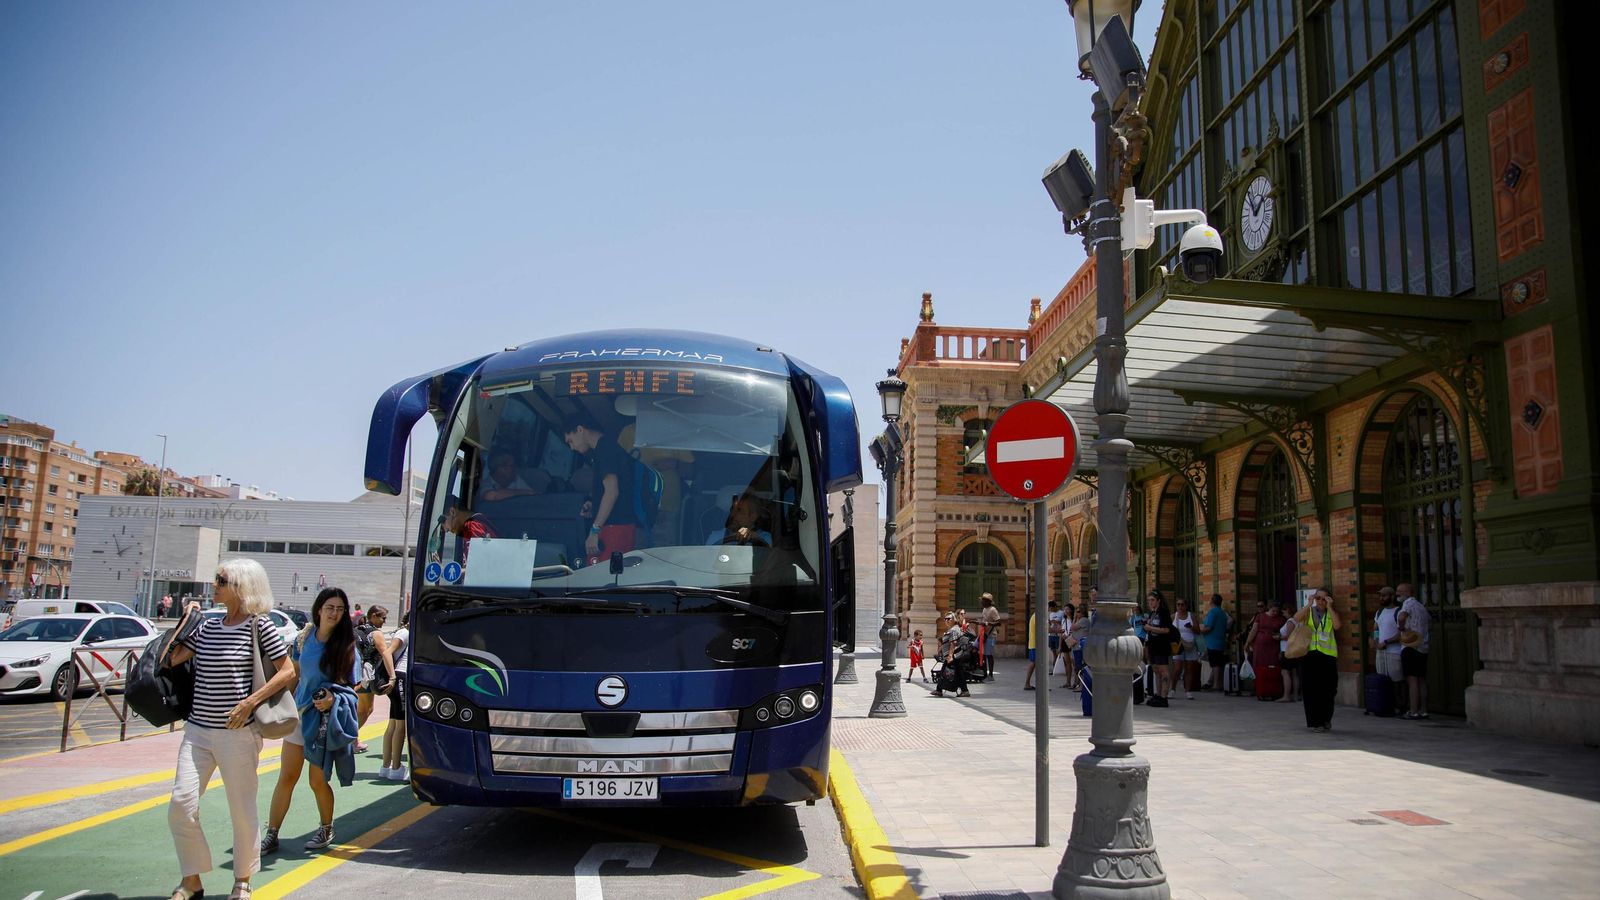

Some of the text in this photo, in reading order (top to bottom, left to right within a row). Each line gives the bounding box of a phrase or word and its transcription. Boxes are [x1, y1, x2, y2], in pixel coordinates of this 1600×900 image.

[538, 348, 724, 363] FRAHERMAR
[569, 370, 696, 395] RENFE
[577, 760, 643, 773] MAN
[576, 781, 654, 796] 5196 JZV
